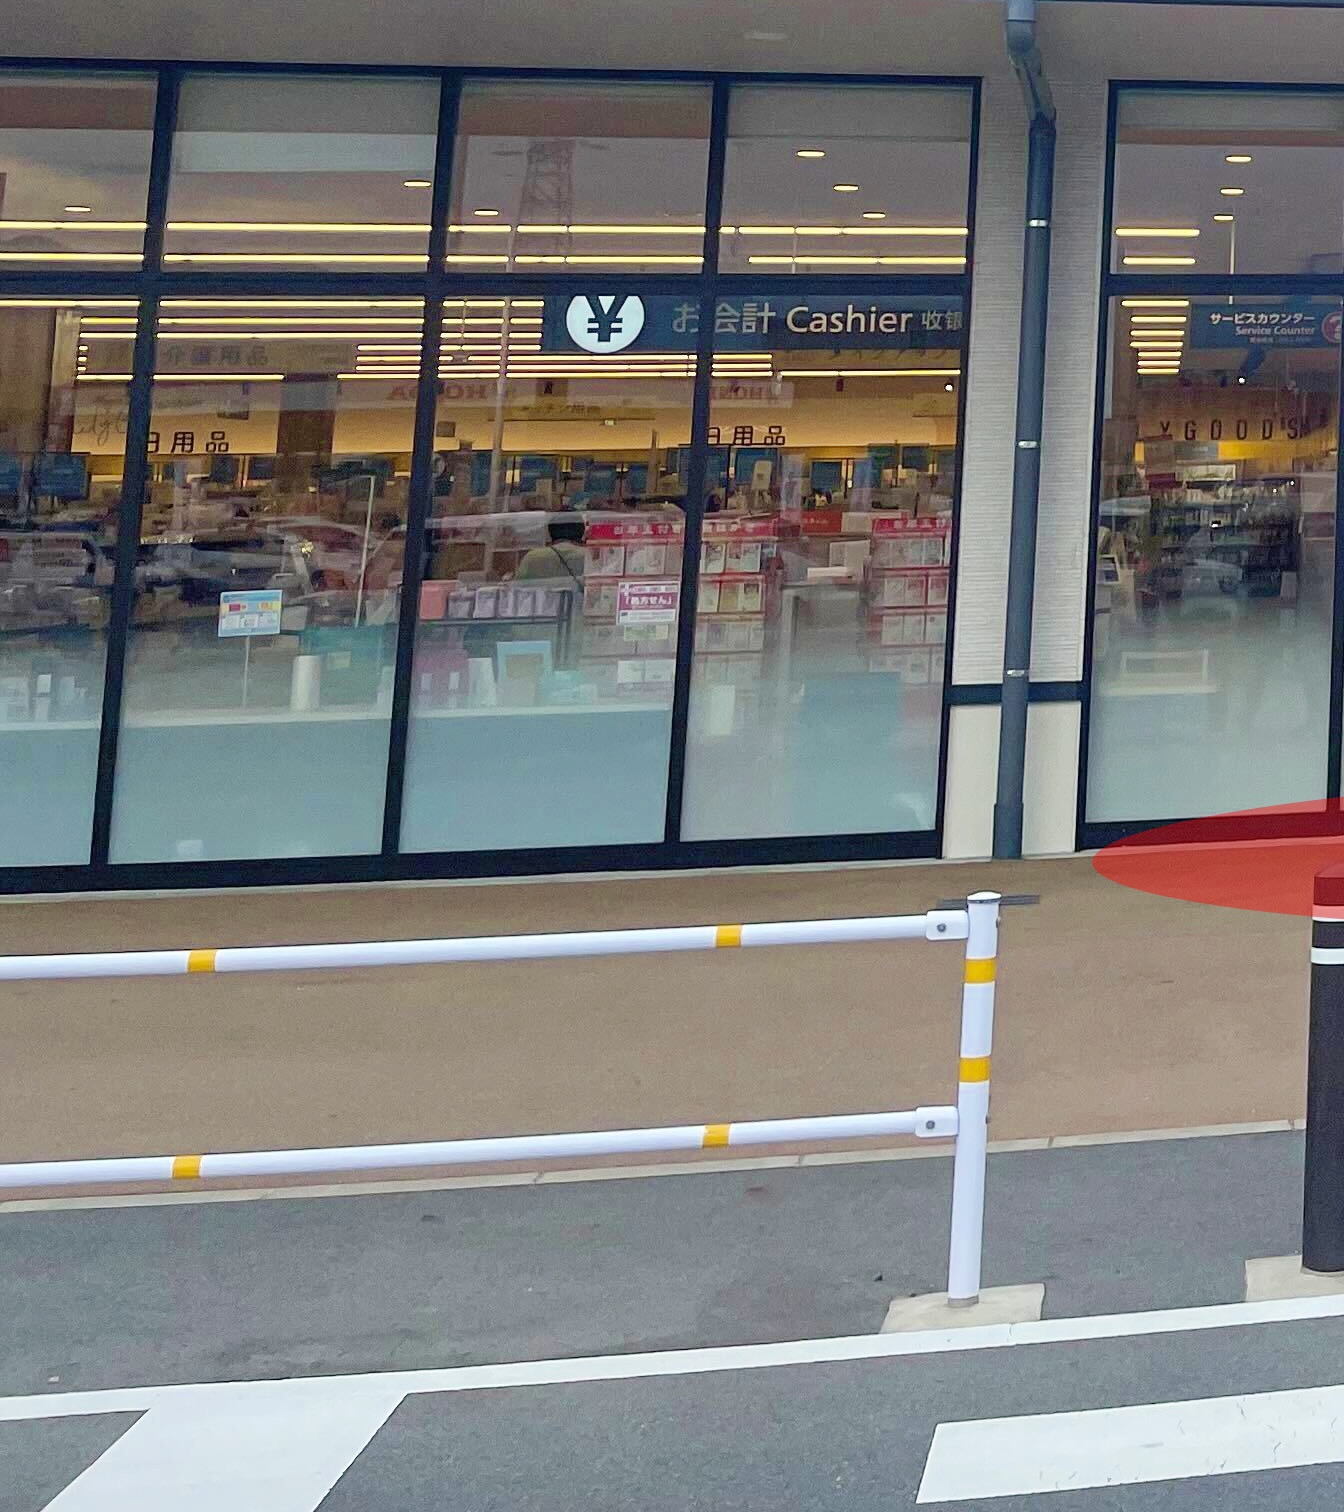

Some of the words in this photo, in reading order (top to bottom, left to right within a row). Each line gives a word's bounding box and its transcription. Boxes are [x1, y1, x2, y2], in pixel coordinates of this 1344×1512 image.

[672, 302, 777, 335] お会計
[786, 304, 914, 334] Cashier
[1209, 312, 1316, 325] サービスカウンター
[1235, 325, 1272, 337] Service
[1273, 325, 1316, 337] Counter
